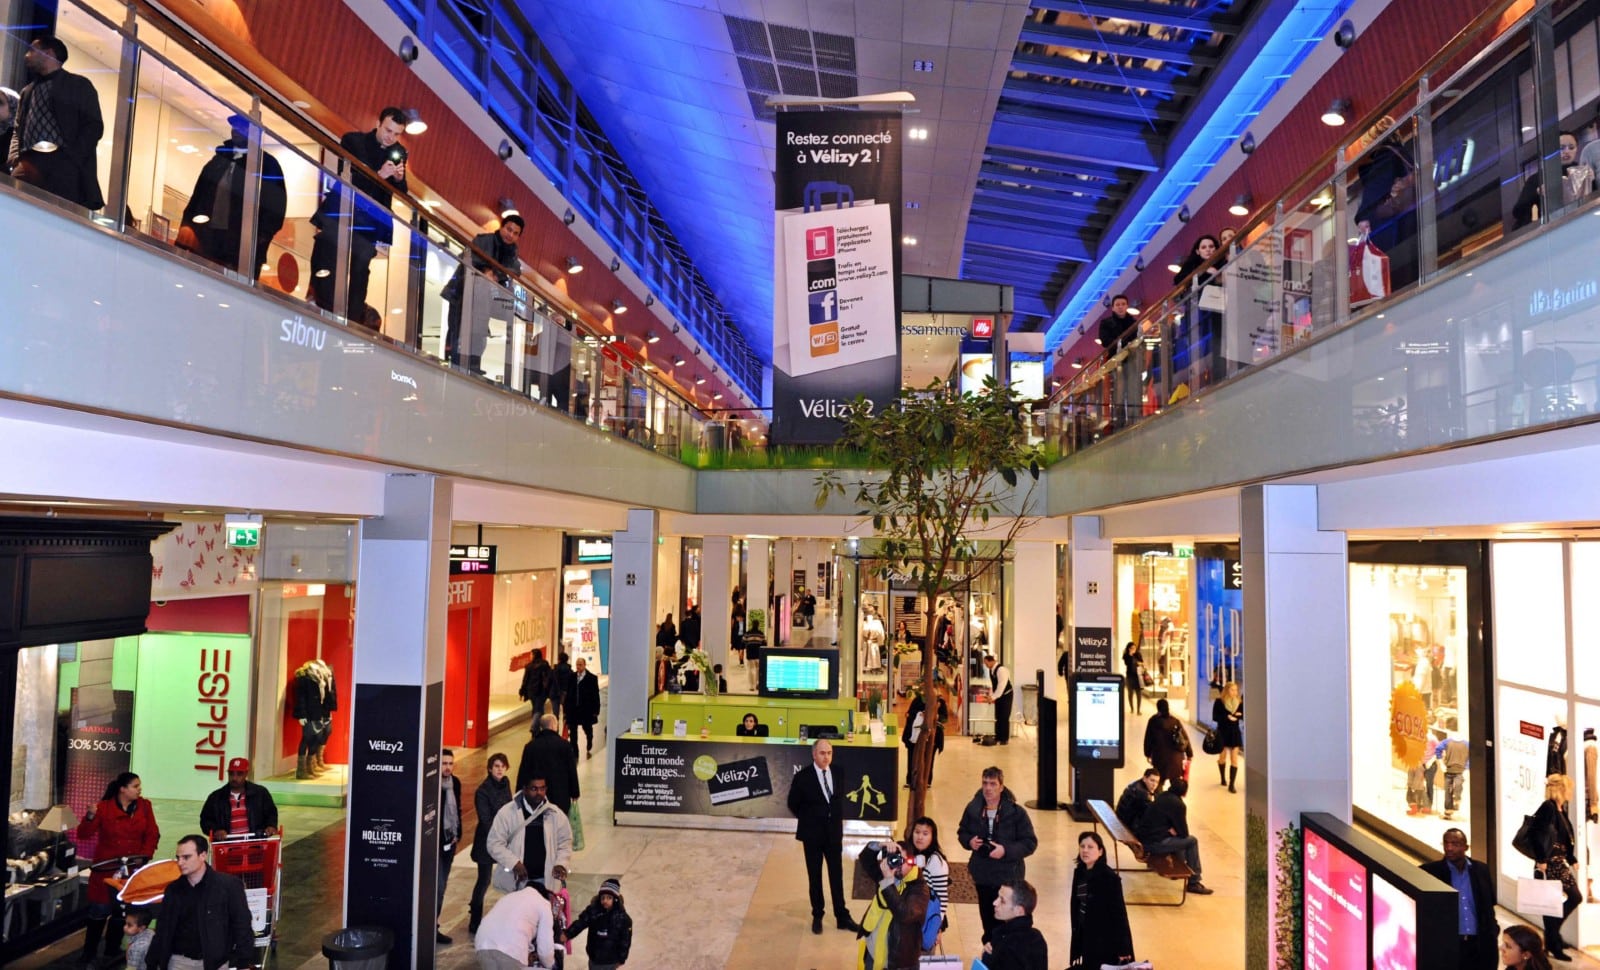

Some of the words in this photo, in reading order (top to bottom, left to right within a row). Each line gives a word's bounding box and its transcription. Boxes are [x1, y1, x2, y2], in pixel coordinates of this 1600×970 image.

[787, 131, 829, 145] Restez
[832, 130, 892, 145] connecté
[797, 150, 807, 164] à
[876, 149, 880, 163] !
[809, 277, 835, 291] .com
[975, 321, 990, 335] illy
[1206, 603, 1239, 688] GAP
[194, 649, 231, 781] ESPRIT
[68, 738, 91, 750] 30%
[92, 739, 116, 752] 50%
[119, 742, 132, 752] 70
[368, 740, 404, 754] Vélizy2
[641, 744, 668, 755] Entrez
[623, 754, 643, 765] dans
[644, 757, 655, 765] un
[657, 755, 685, 766] monde
[366, 764, 404, 772] ACCUEILLE
[715, 765, 759, 784] Vélizy2
[793, 765, 802, 775] N
[362, 830, 402, 842] HOLLISTER
